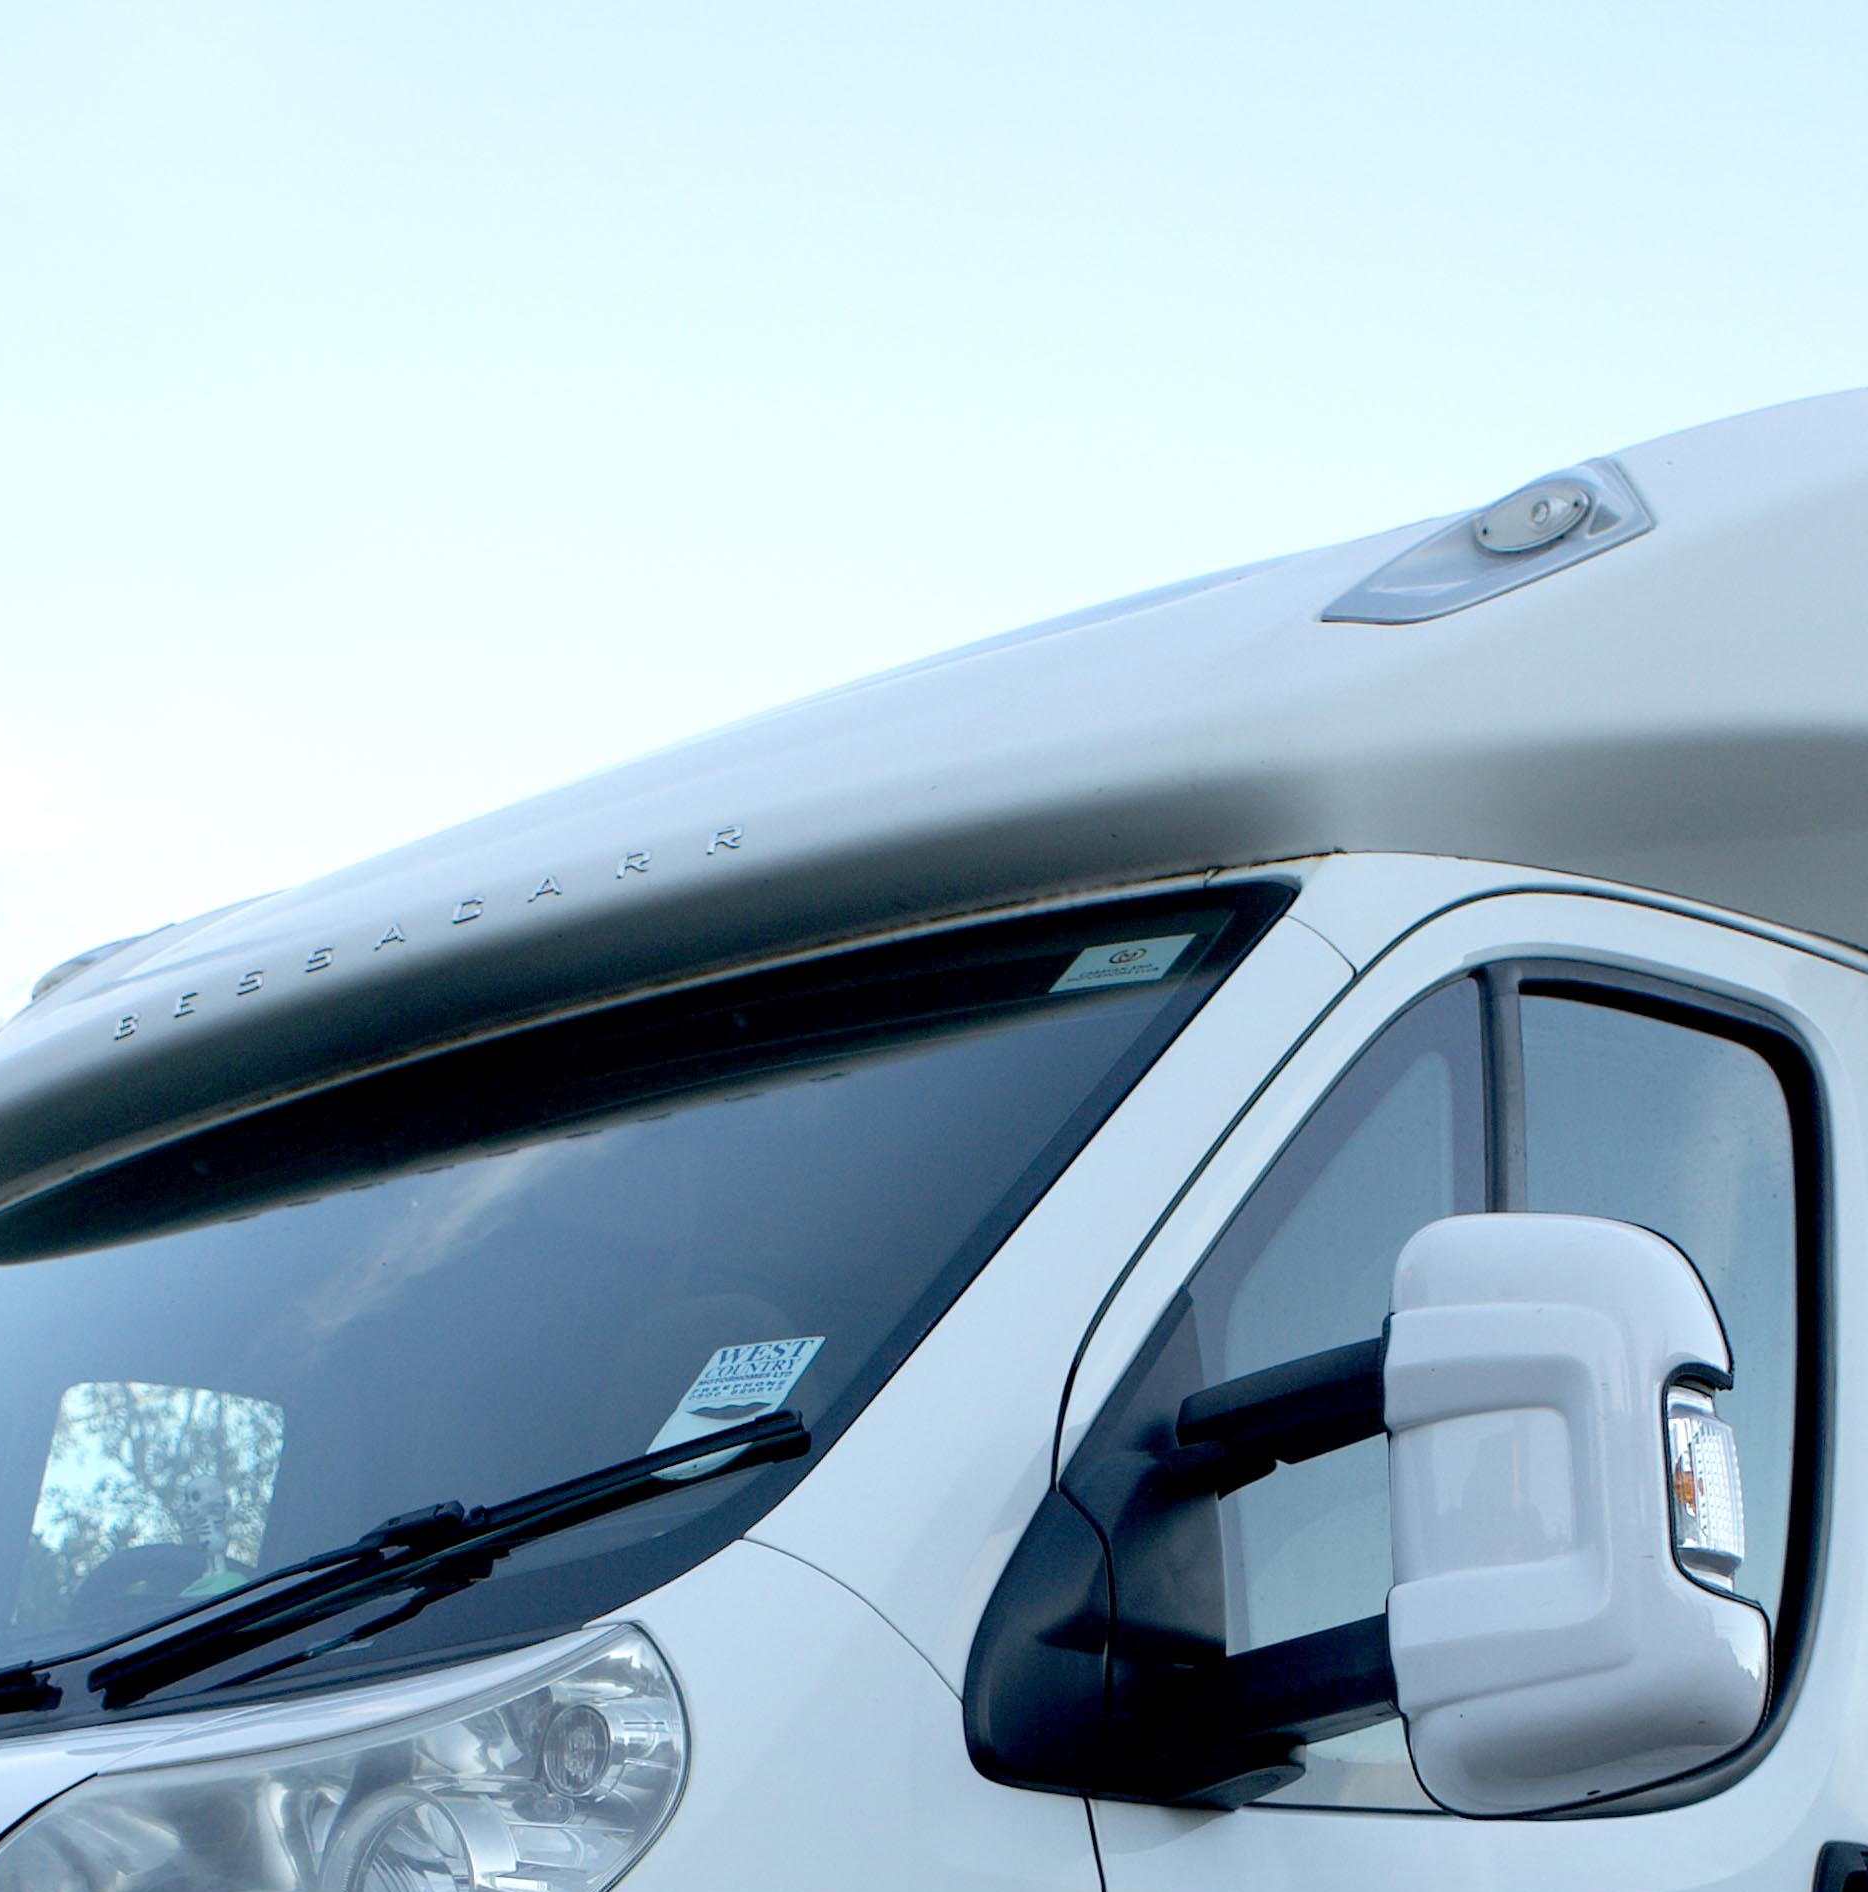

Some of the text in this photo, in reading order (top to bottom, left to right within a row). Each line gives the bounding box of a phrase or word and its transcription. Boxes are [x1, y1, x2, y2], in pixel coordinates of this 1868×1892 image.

[114, 824, 744, 1040] BESSACARR
[720, 1340, 815, 1365] WEST
[704, 1357, 802, 1379] COUNTRY
